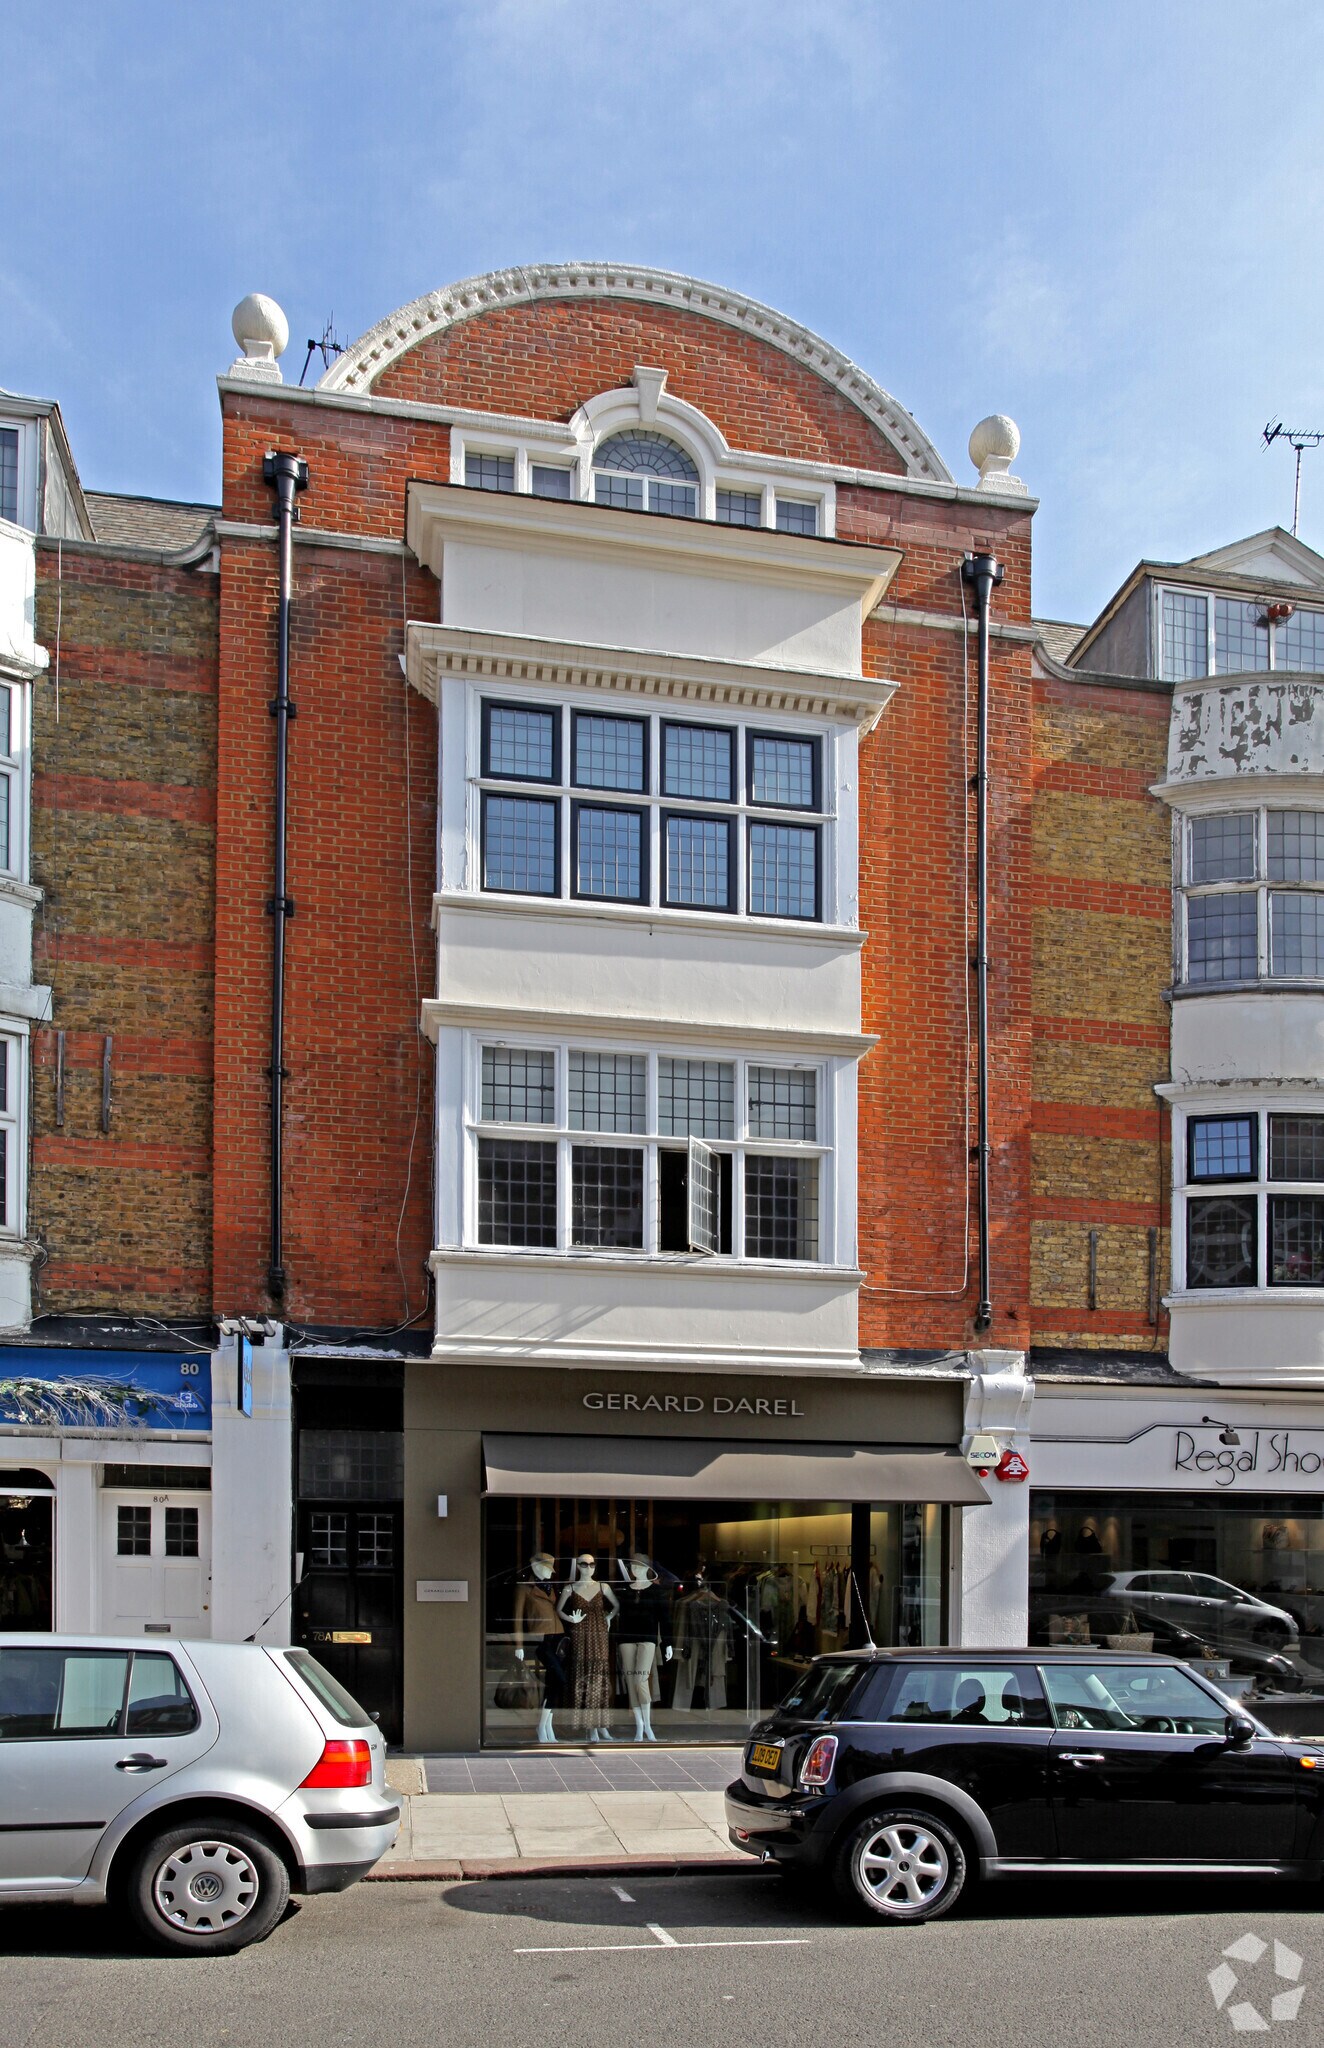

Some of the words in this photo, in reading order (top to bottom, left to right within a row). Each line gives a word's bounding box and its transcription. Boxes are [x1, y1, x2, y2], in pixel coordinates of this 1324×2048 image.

[180, 1363, 199, 1375] 80
[174, 1401, 198, 1409] Chubb
[582, 1392, 705, 1413] GERARD
[713, 1397, 805, 1416] DAREL
[1174, 1431, 1260, 1486] Regal
[1267, 1432, 1324, 1473] Sho
[153, 1495, 169, 1503] 80A
[312, 1631, 332, 1642] 78A
